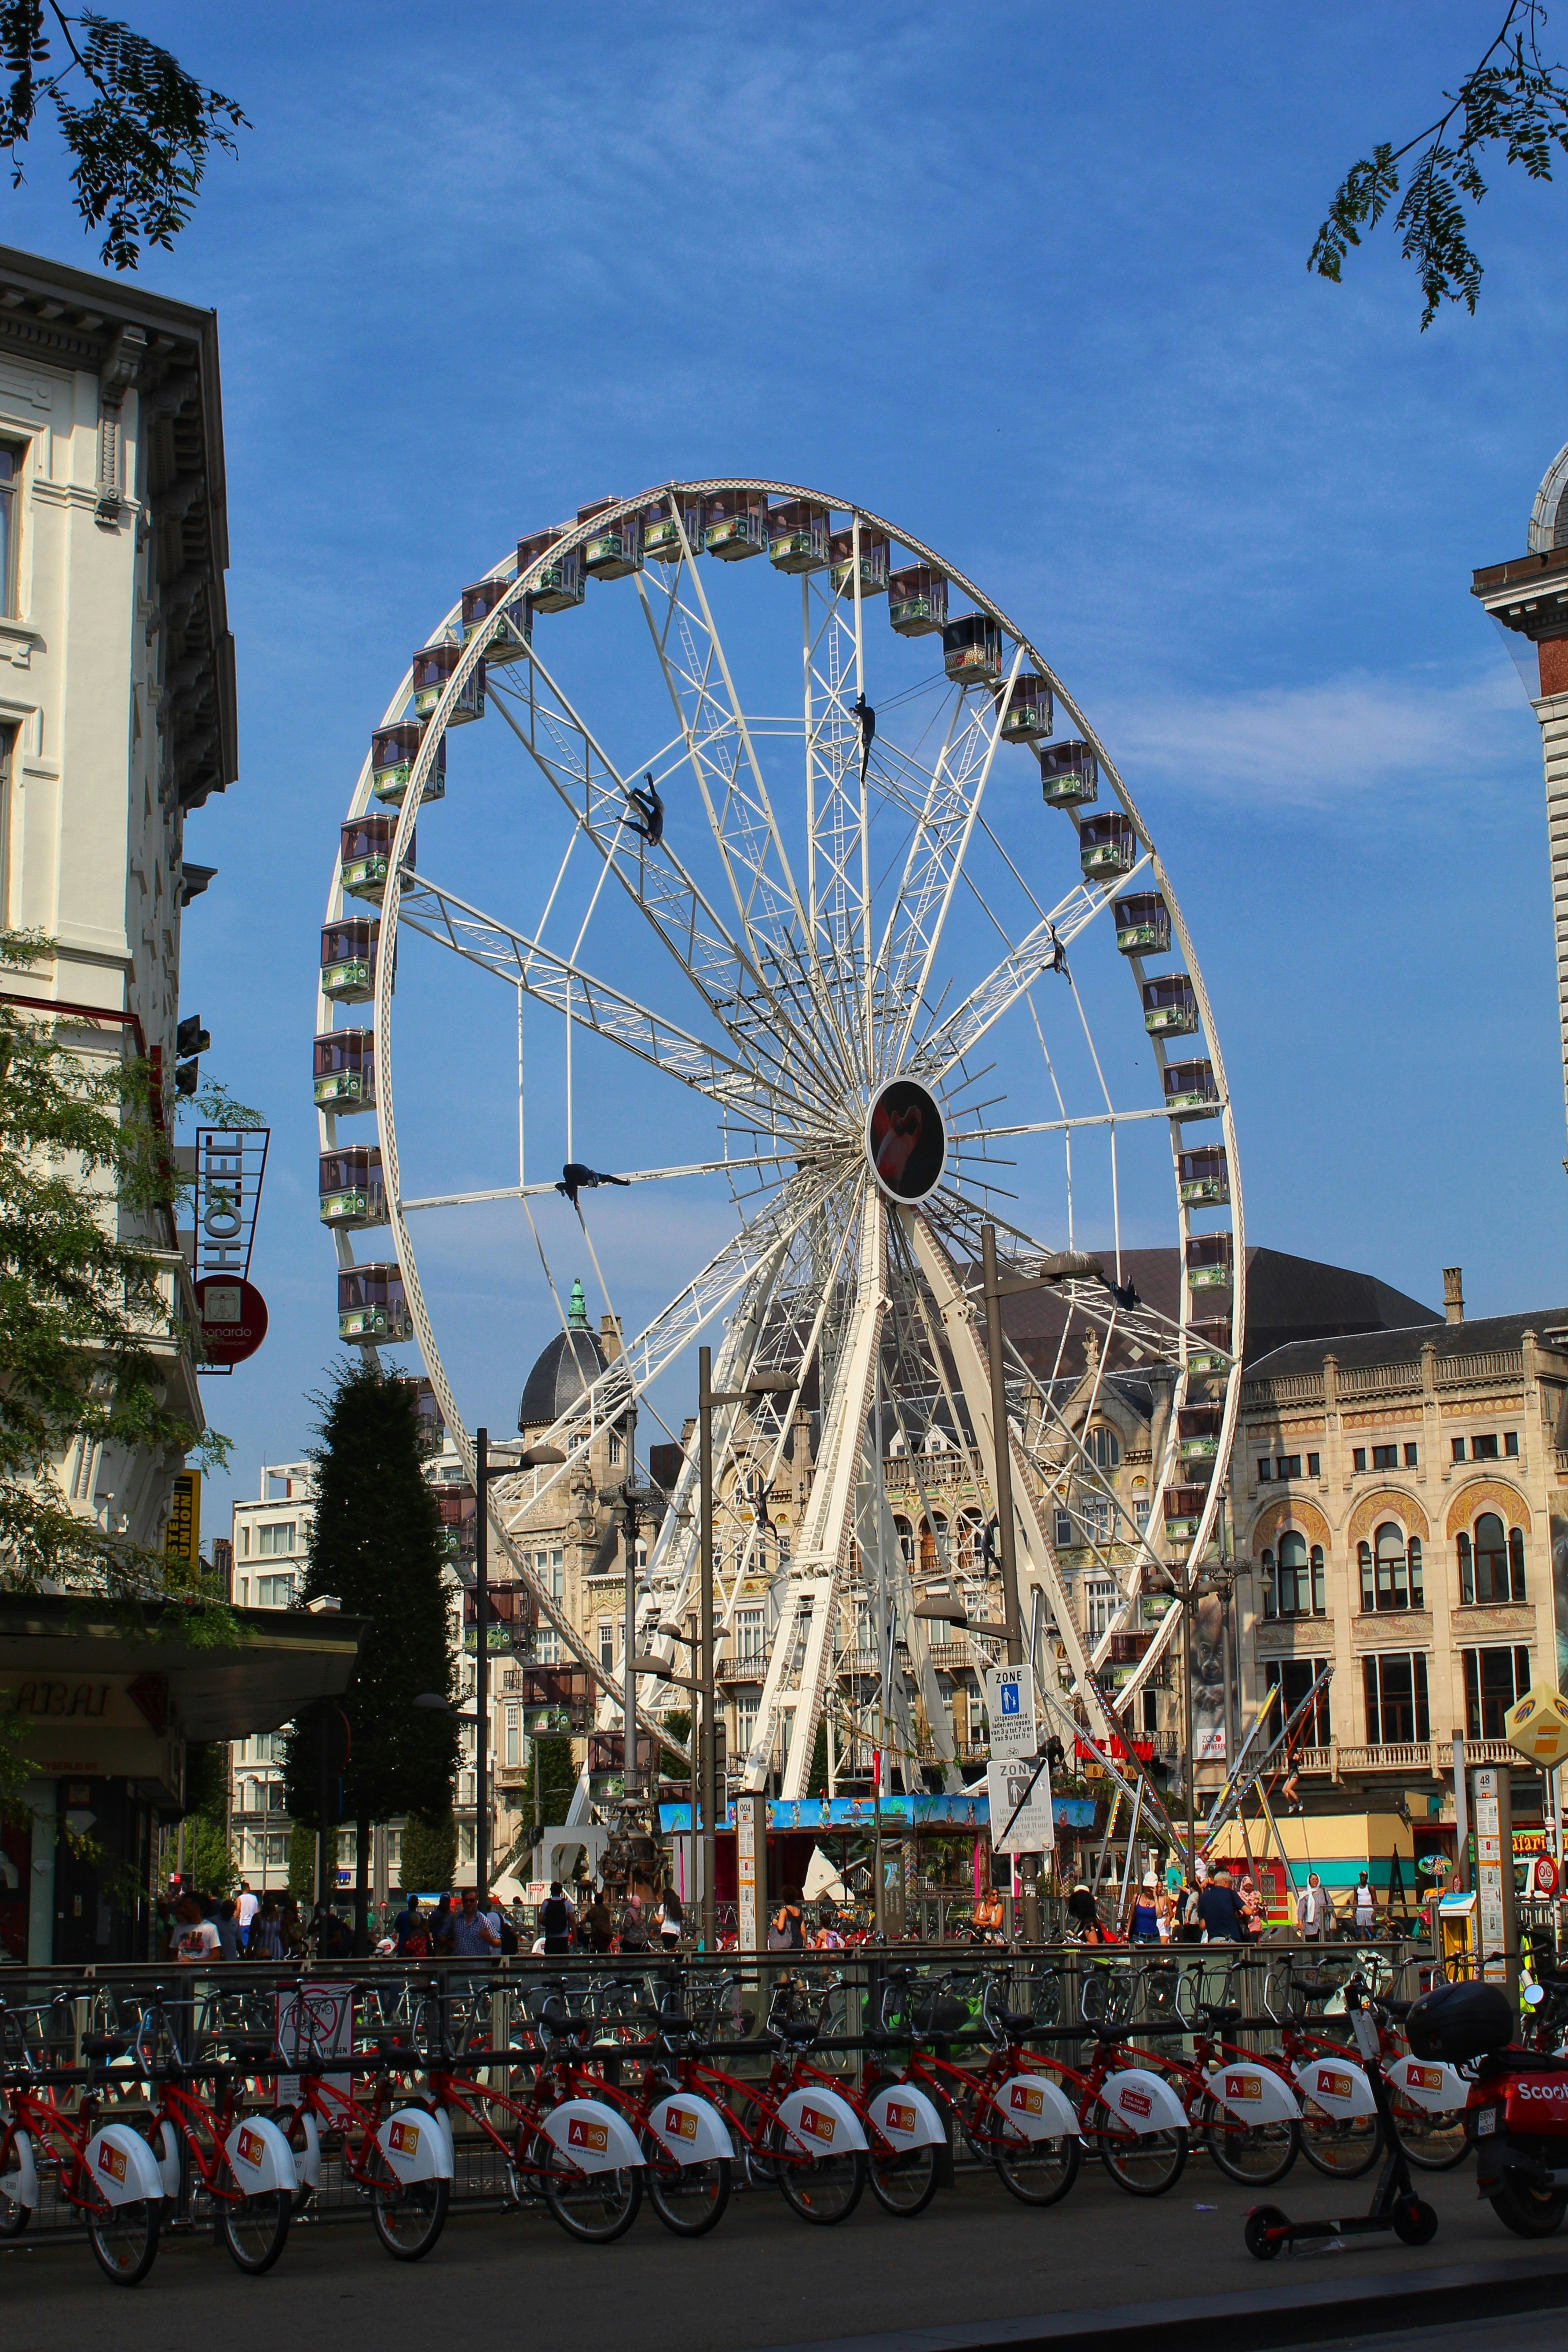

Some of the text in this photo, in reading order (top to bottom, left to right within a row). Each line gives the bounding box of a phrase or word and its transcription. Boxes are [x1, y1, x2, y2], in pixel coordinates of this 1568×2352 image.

[204, 1134, 243, 1270] HOTEL
[201, 1327, 252, 1337] eonardo
[179, 1496, 191, 1557] UNION
[995, 1671, 1022, 1684] ZONE
[994, 1713, 1028, 1722] Uitgezonderd
[1480, 1774, 1490, 1785] 48
[740, 1804, 750, 1813] 004
[1512, 1834, 1546, 1851] afari
[1321, 2076, 1330, 2088] A
[1411, 2070, 1420, 2082] A
[1230, 2081, 1239, 2093] A
[1014, 2092, 1022, 2104] A
[1123, 2099, 1147, 2112] Antwerpen
[669, 2114, 676, 2128] A
[804, 2114, 812, 2128] A
[890, 2109, 897, 2122] A
[341, 2117, 349, 2128] A
[1483, 2123, 1494, 2133] 660
[392, 2129, 399, 2144] A
[573, 2127, 583, 2141] A
[240, 2136, 247, 2151] A
[102, 2150, 108, 2166] A
